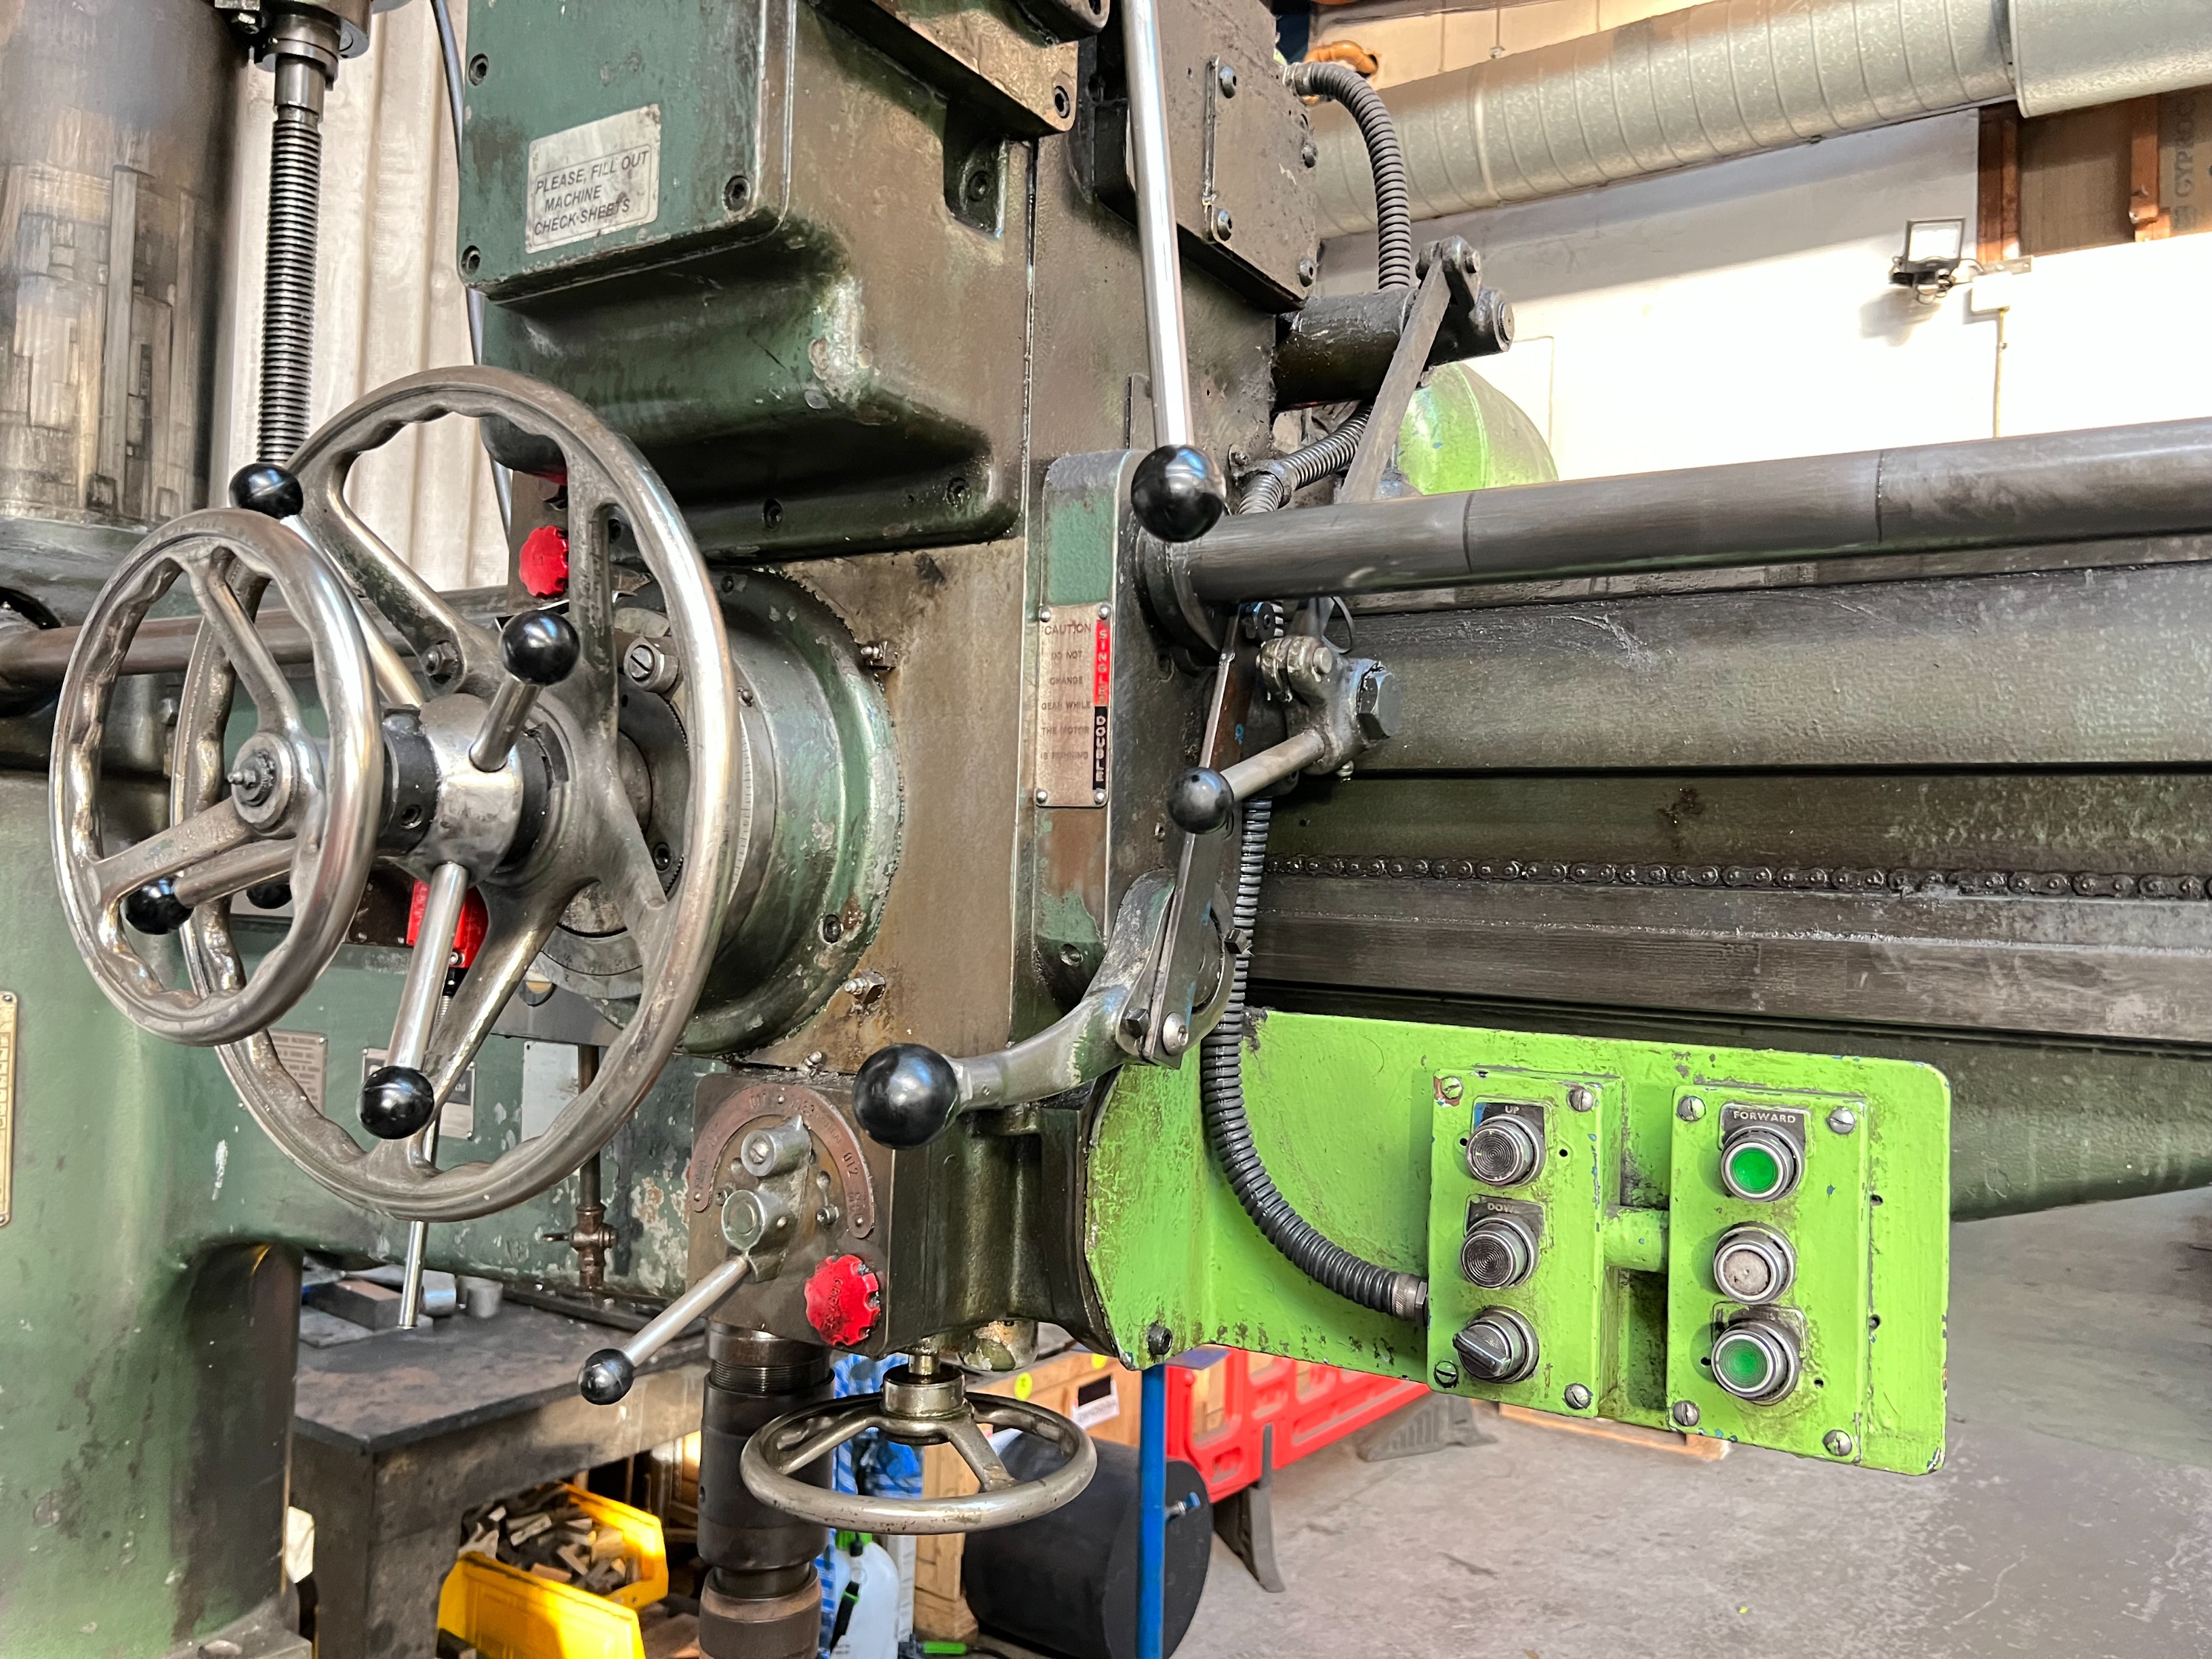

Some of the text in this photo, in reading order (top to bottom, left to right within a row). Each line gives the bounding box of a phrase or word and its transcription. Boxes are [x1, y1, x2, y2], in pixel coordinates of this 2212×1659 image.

[535, 150, 649, 194] PLEASE, FILL OUT
[545, 184, 602, 213] MACHINE
[1044, 623, 1091, 635] CAUTION
[1066, 651, 1083, 659] NOT
[1050, 676, 1083, 685] CHANGE
[1066, 701, 1091, 710] WHILE
[1095, 715, 1106, 782] DOUBLE
[1504, 1105, 1519, 1113] UP
[1733, 1110, 1796, 1124] FORWARD
